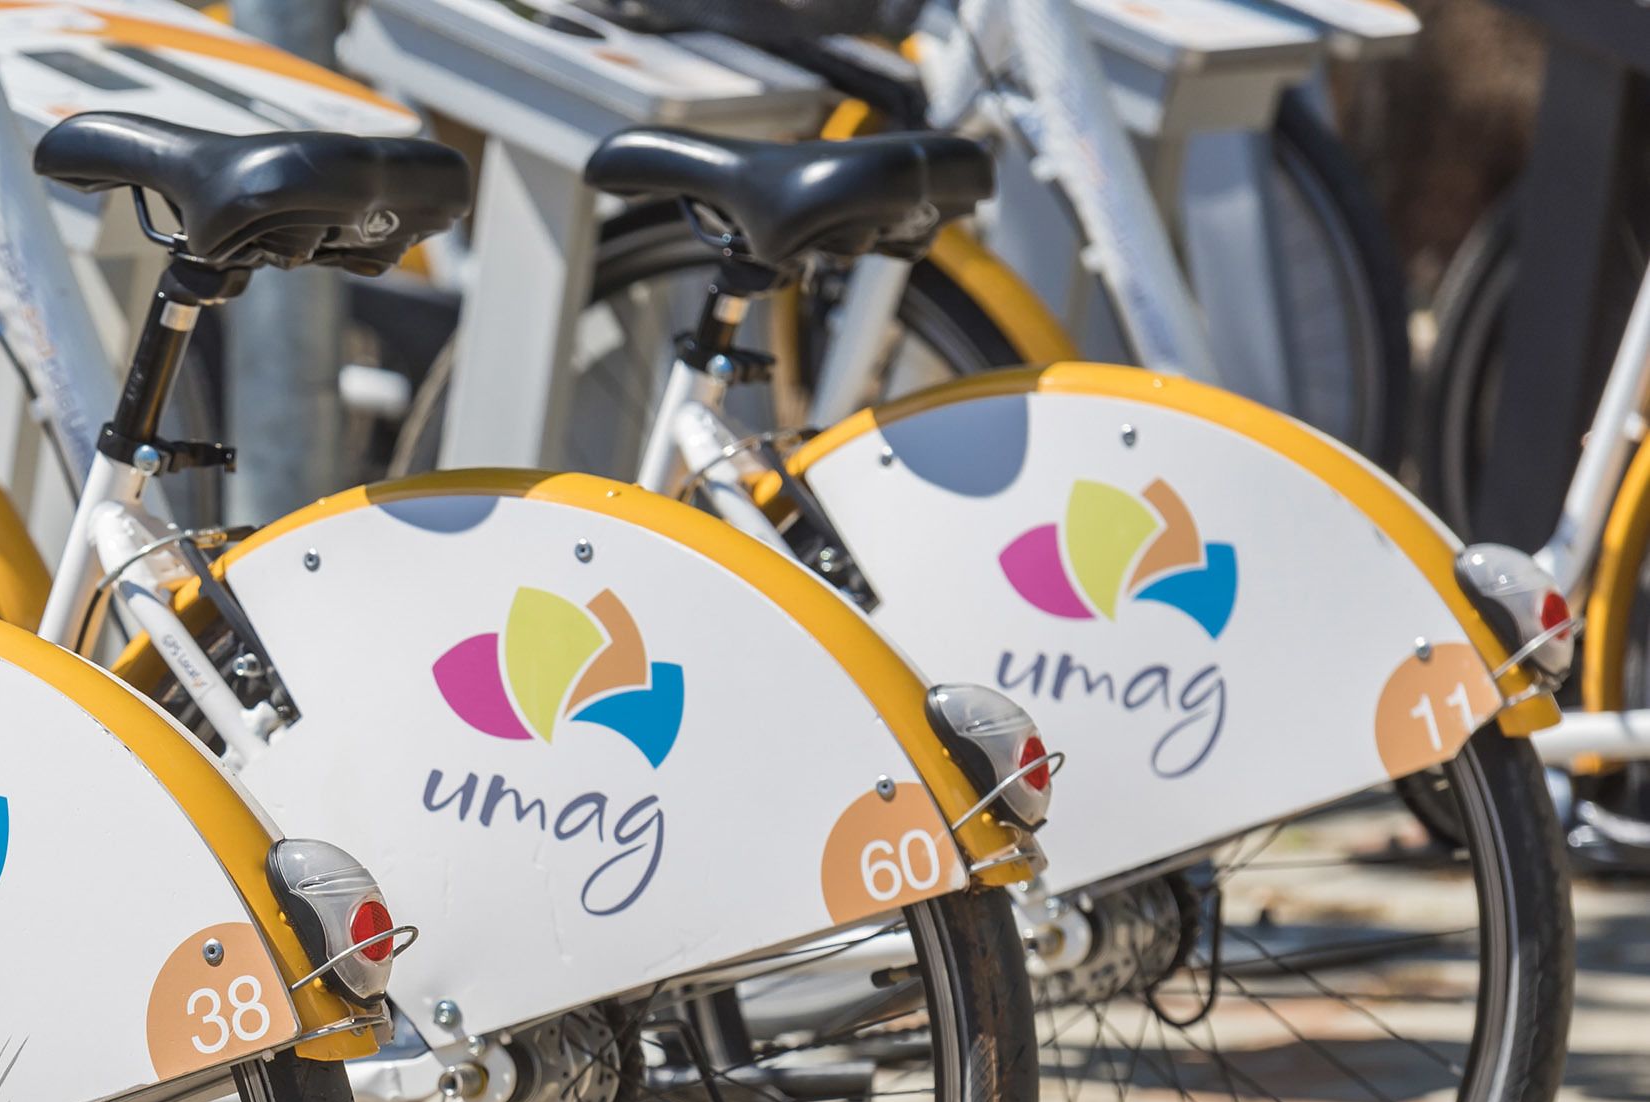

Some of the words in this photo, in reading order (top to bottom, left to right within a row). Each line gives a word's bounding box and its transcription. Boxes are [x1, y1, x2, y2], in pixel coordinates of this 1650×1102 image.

[995, 650, 1227, 780] umag
[1410, 682, 1476, 753] 11
[421, 768, 666, 918] umag
[861, 829, 940, 900] 60
[185, 975, 271, 1055] 38
